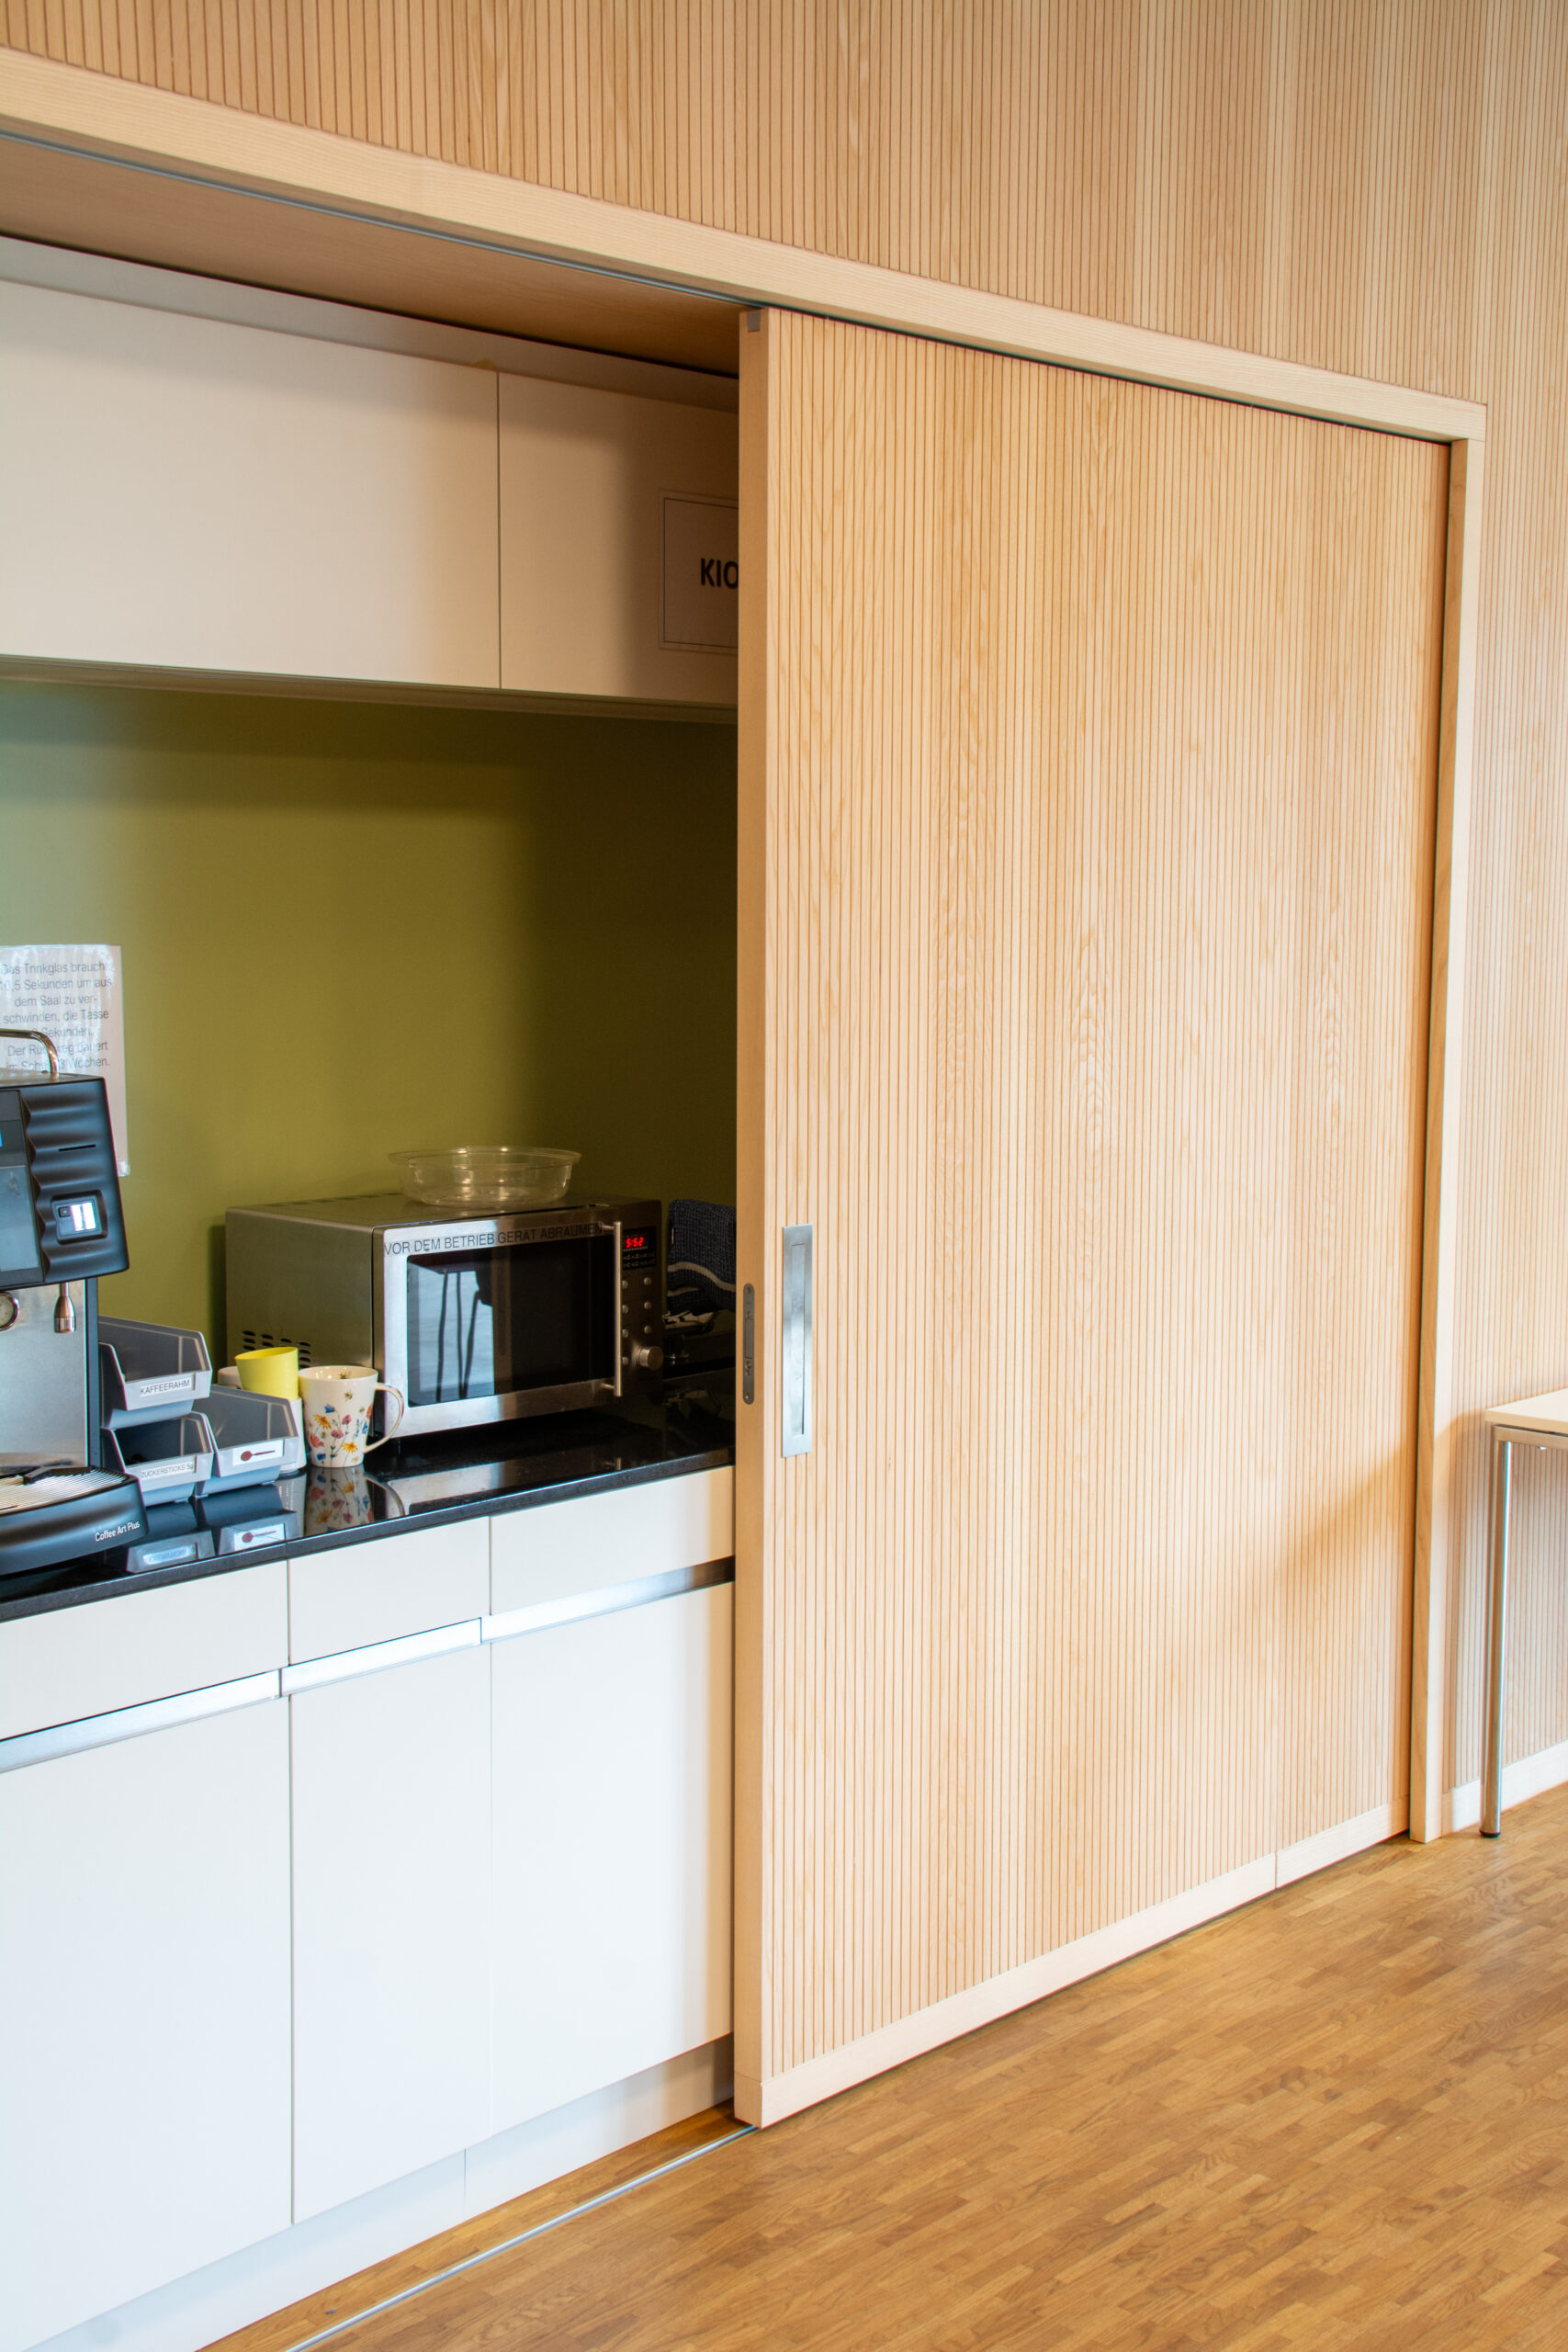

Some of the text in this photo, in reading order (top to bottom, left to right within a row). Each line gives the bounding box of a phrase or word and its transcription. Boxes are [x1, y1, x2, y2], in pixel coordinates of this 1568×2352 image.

[701, 558, 739, 589] KIO
[23, 978, 73, 990] Sekunden
[95, 978, 112, 988] aus
[15, 996, 37, 1007] dem
[39, 995, 62, 1006] Saal
[64, 996, 75, 1005] zu
[62, 1011, 78, 1021] die
[81, 1009, 109, 1020] Tasse
[7, 1045, 26, 1057] Der
[384, 1241, 412, 1256] VOR
[414, 1238, 441, 1253] DEM
[444, 1233, 495, 1250] BETRIEB
[626, 1237, 645, 1249] 5:52
[141, 1379, 190, 1395] KAFFEERAHM
[95, 1521, 141, 1542] Coffee Art Plus
